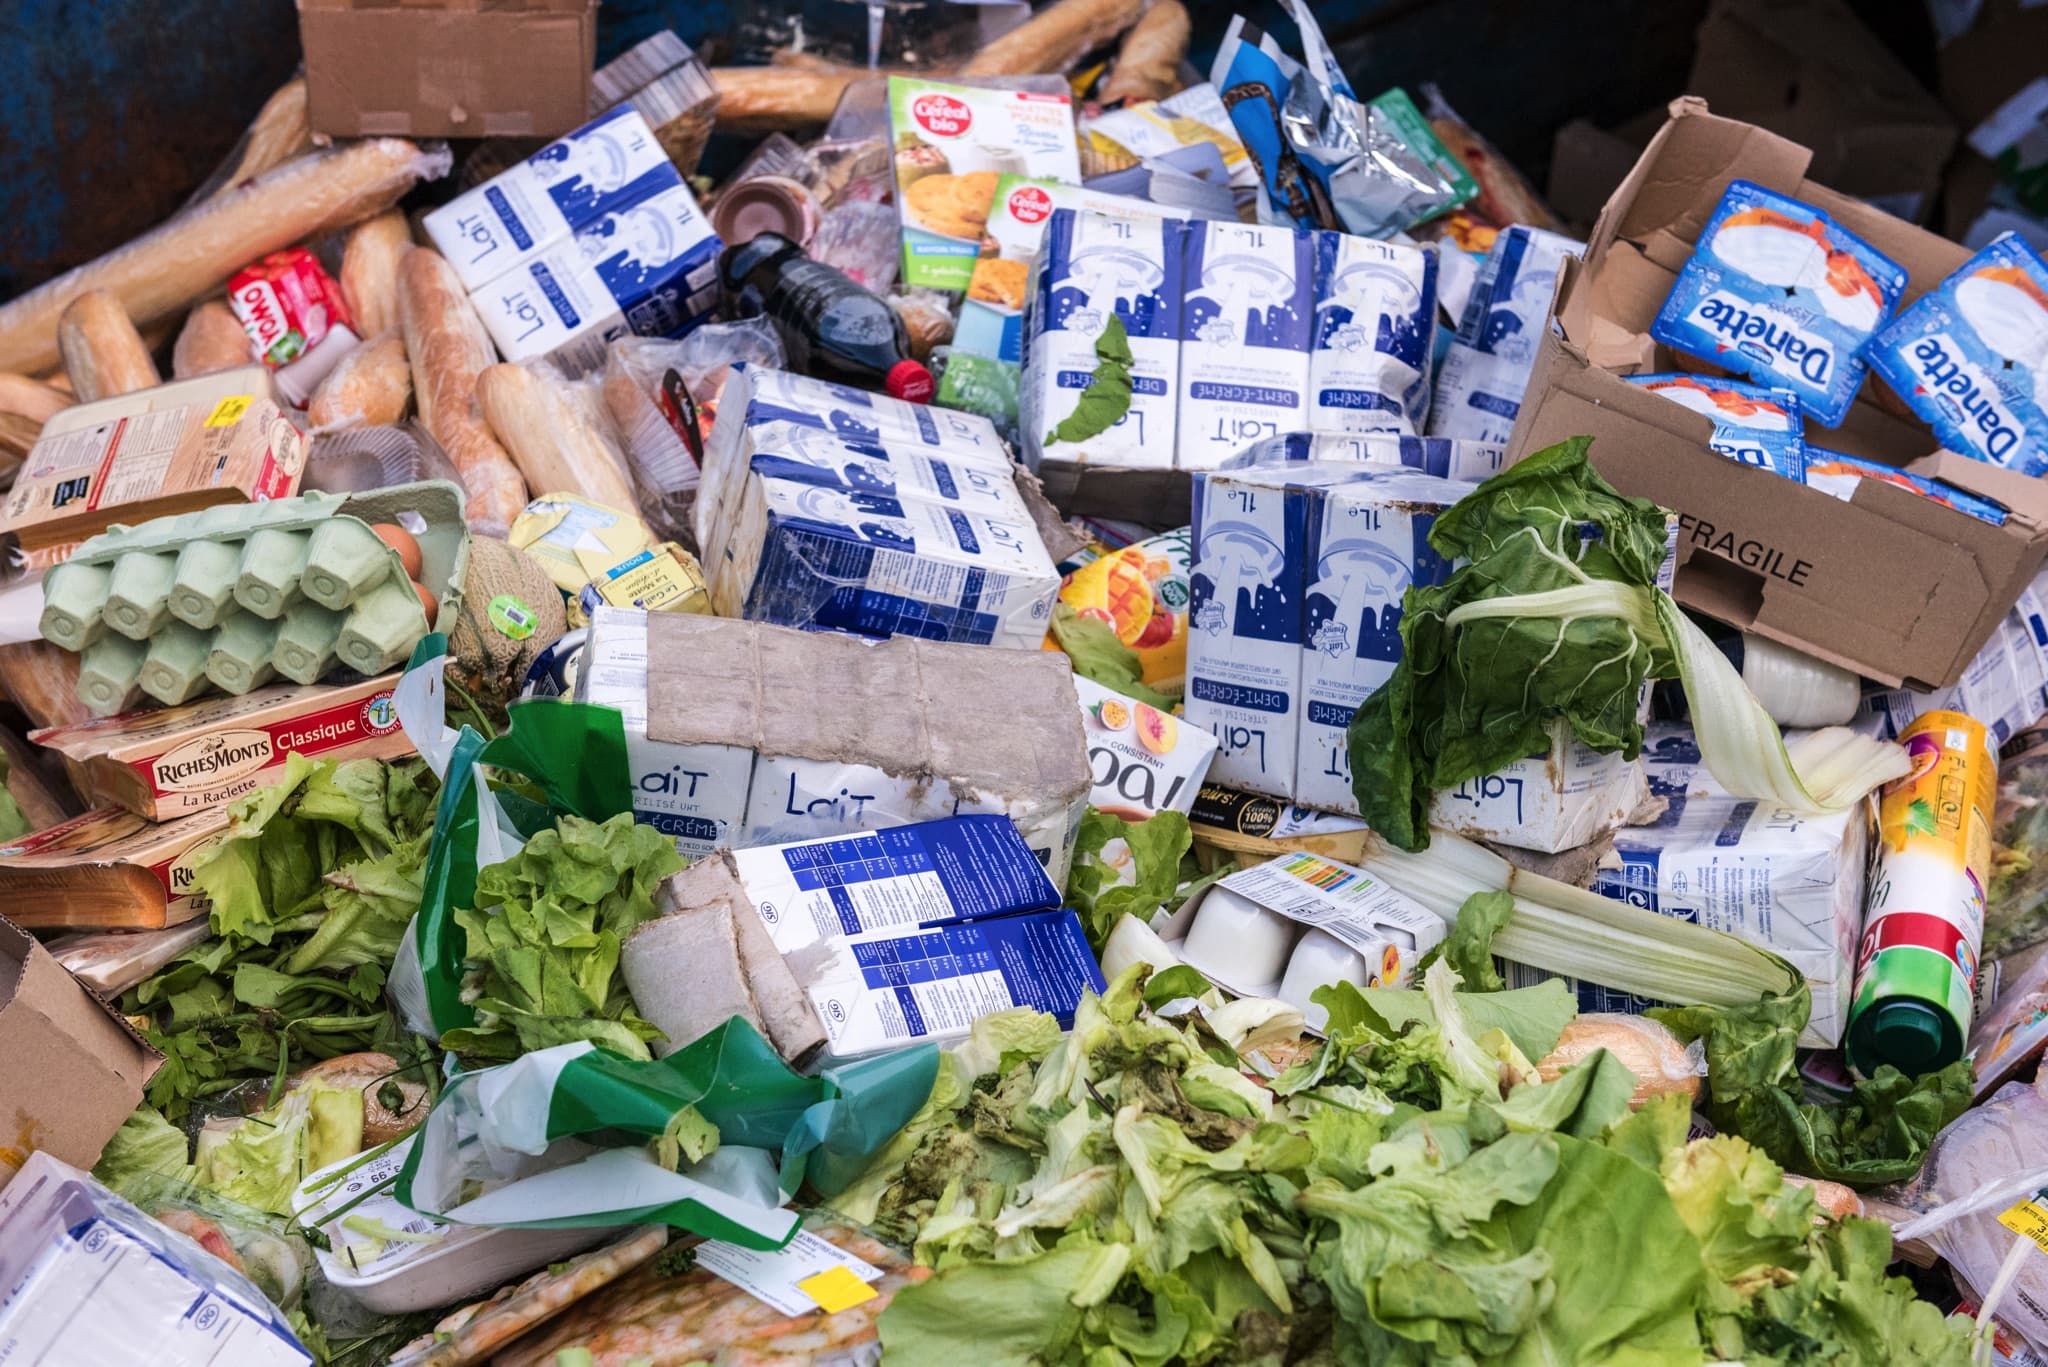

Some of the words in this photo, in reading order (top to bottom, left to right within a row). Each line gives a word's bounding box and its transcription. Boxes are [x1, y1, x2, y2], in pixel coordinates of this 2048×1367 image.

[1700, 296, 1832, 390] Danette
[1914, 338, 2021, 463] Danette
[1678, 512, 1815, 588] FRAGILE
[276, 717, 358, 751] Classique
[1110, 740, 1166, 770] CONSISTANT
[182, 793, 200, 808] La
[202, 777, 258, 806] Raclette
[629, 764, 709, 798] aiT
[1244, 810, 1275, 825] 100%
[830, 1001, 844, 1020] SIG
